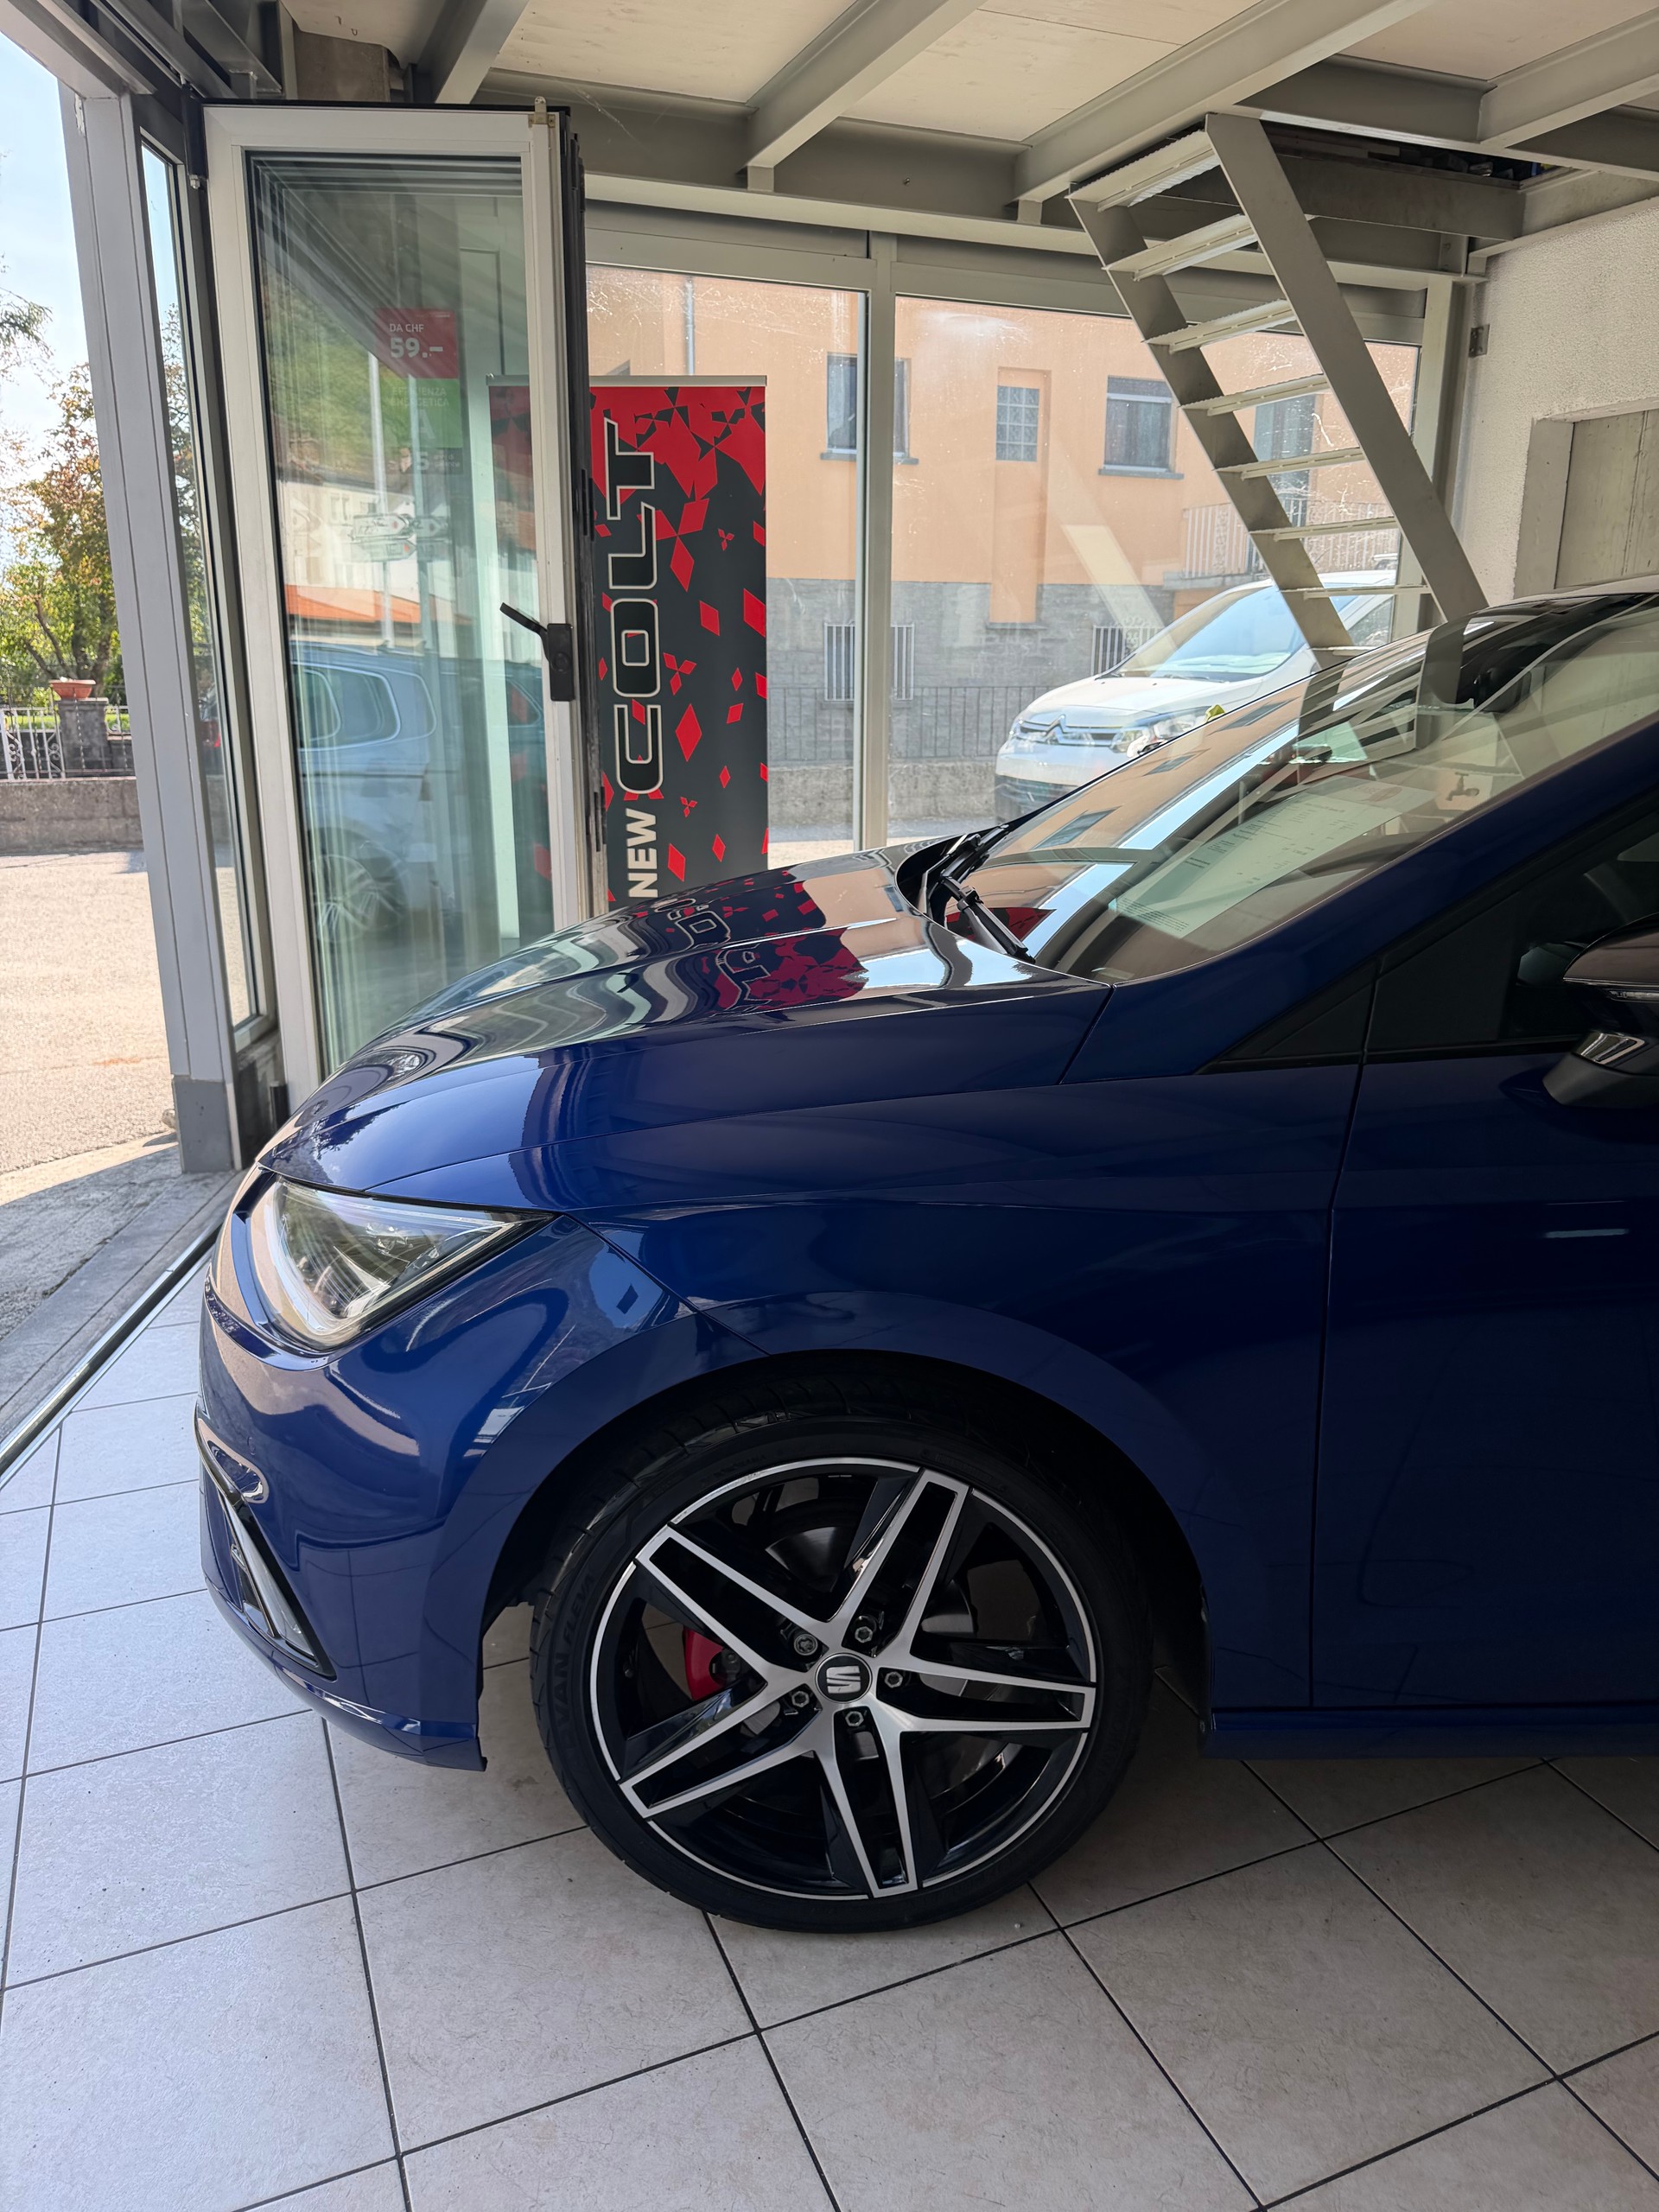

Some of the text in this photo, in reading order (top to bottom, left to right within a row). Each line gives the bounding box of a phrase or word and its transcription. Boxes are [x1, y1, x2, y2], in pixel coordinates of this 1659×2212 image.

[389, 323, 425, 333] DA CHF
[391, 386, 448, 397] EFFIENZA
[390, 397, 450, 407] ENEGETICA
[603, 416, 664, 899] NEW COLT
